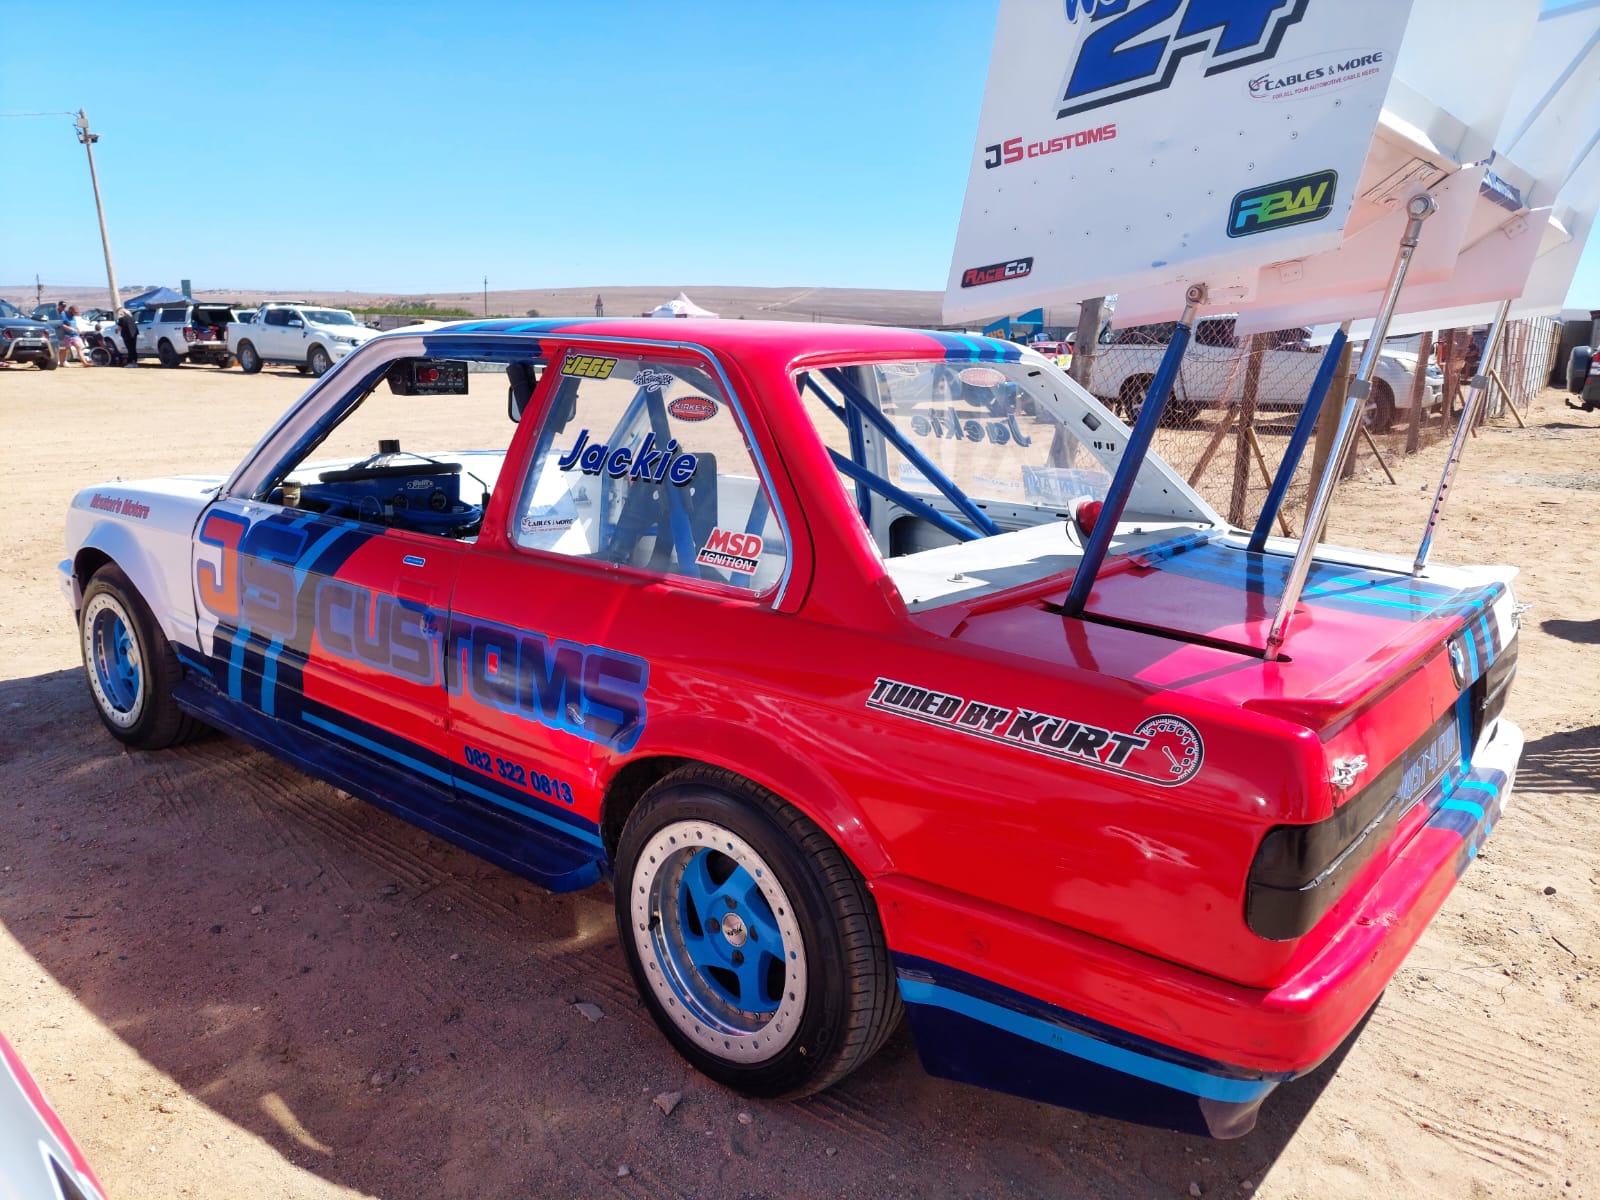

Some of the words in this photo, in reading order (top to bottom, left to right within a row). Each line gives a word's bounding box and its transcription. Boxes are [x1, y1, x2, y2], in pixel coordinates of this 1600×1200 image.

[1264, 67, 1325, 91] CABLES
[1337, 52, 1383, 73] MORE
[985, 137, 1024, 169] JS
[1027, 123, 1117, 158] CUSTOMS
[562, 355, 618, 379] JEGS
[558, 429, 698, 488] Jackie
[702, 551, 753, 571] IGNITION
[706, 528, 762, 559] MSD
[197, 508, 298, 640] JS
[313, 576, 650, 755] CUSTOMS
[870, 677, 964, 722] TUNED
[958, 700, 1012, 733] BY
[1007, 707, 1151, 767] KURT
[464, 745, 494, 773] 082
[495, 756, 528, 787] 322
[530, 770, 574, 805] 0813
